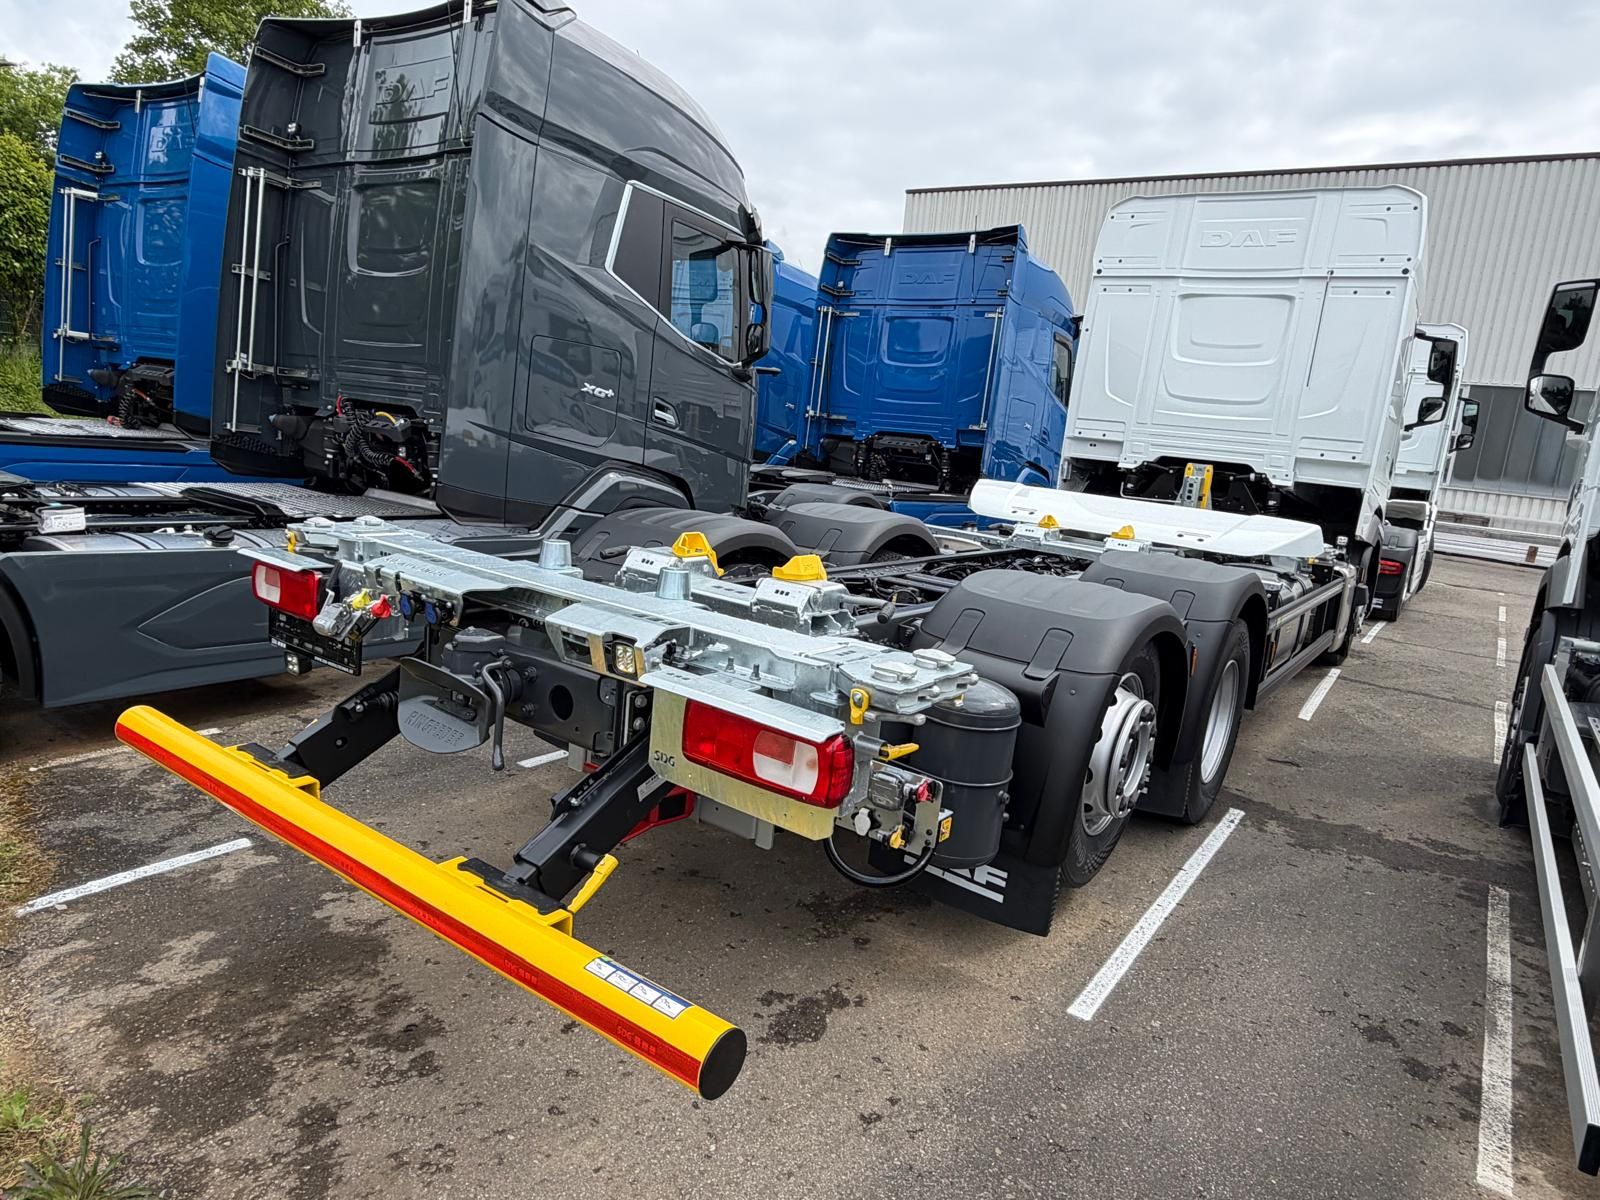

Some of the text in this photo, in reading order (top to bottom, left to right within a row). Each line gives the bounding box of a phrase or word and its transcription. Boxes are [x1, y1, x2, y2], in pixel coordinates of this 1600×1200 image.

[1199, 228, 1297, 248] DAF
[898, 271, 957, 285] DAF
[653, 750, 676, 768] SDG
